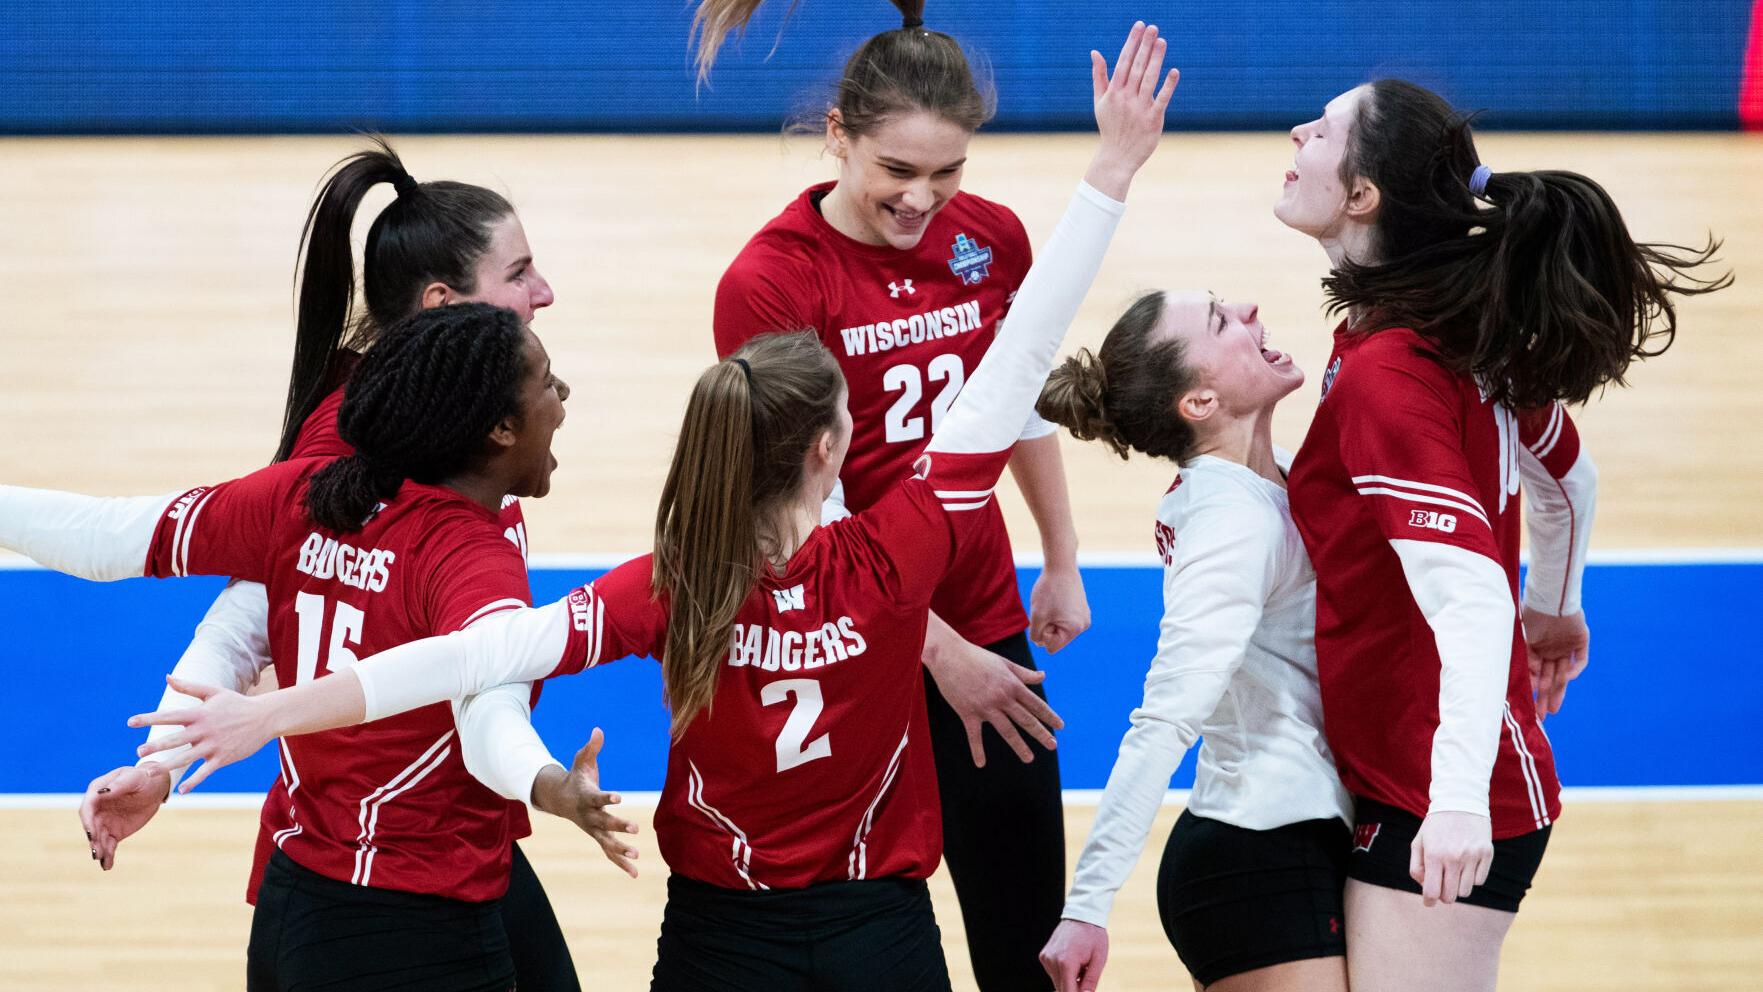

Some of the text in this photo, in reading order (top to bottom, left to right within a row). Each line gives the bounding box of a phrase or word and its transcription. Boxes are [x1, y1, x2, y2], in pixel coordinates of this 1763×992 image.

[840, 300, 982, 357] WISCONSIN
[883, 353, 964, 443] 22
[296, 532, 395, 593] BADGERS
[774, 584, 806, 614] W
[295, 590, 365, 687] 15
[728, 615, 867, 672] BADGERS
[760, 678, 832, 773] 2
